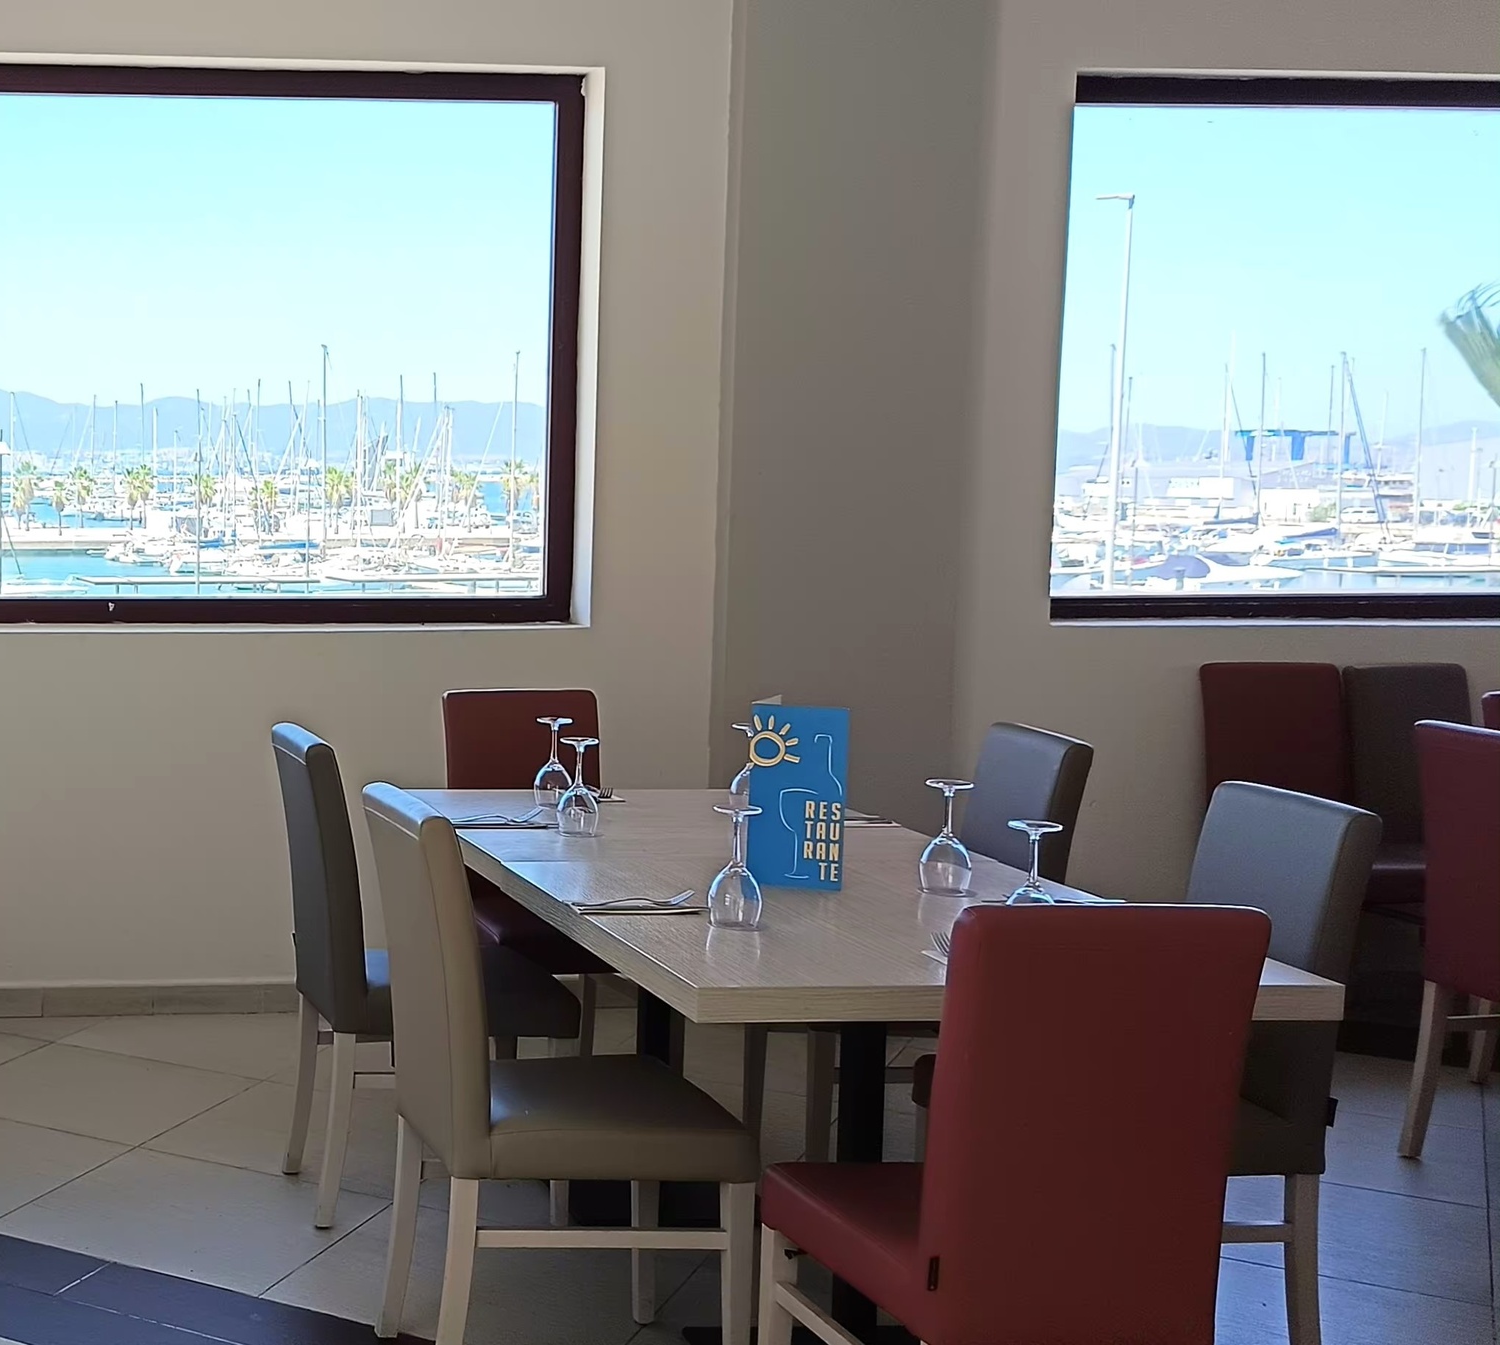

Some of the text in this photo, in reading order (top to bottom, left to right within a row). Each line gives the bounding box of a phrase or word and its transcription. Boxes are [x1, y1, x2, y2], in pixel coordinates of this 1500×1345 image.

[804, 800, 841, 820] RES
[804, 821, 840, 841] TAU
[803, 841, 839, 861] RAN
[818, 862, 839, 882] TE
